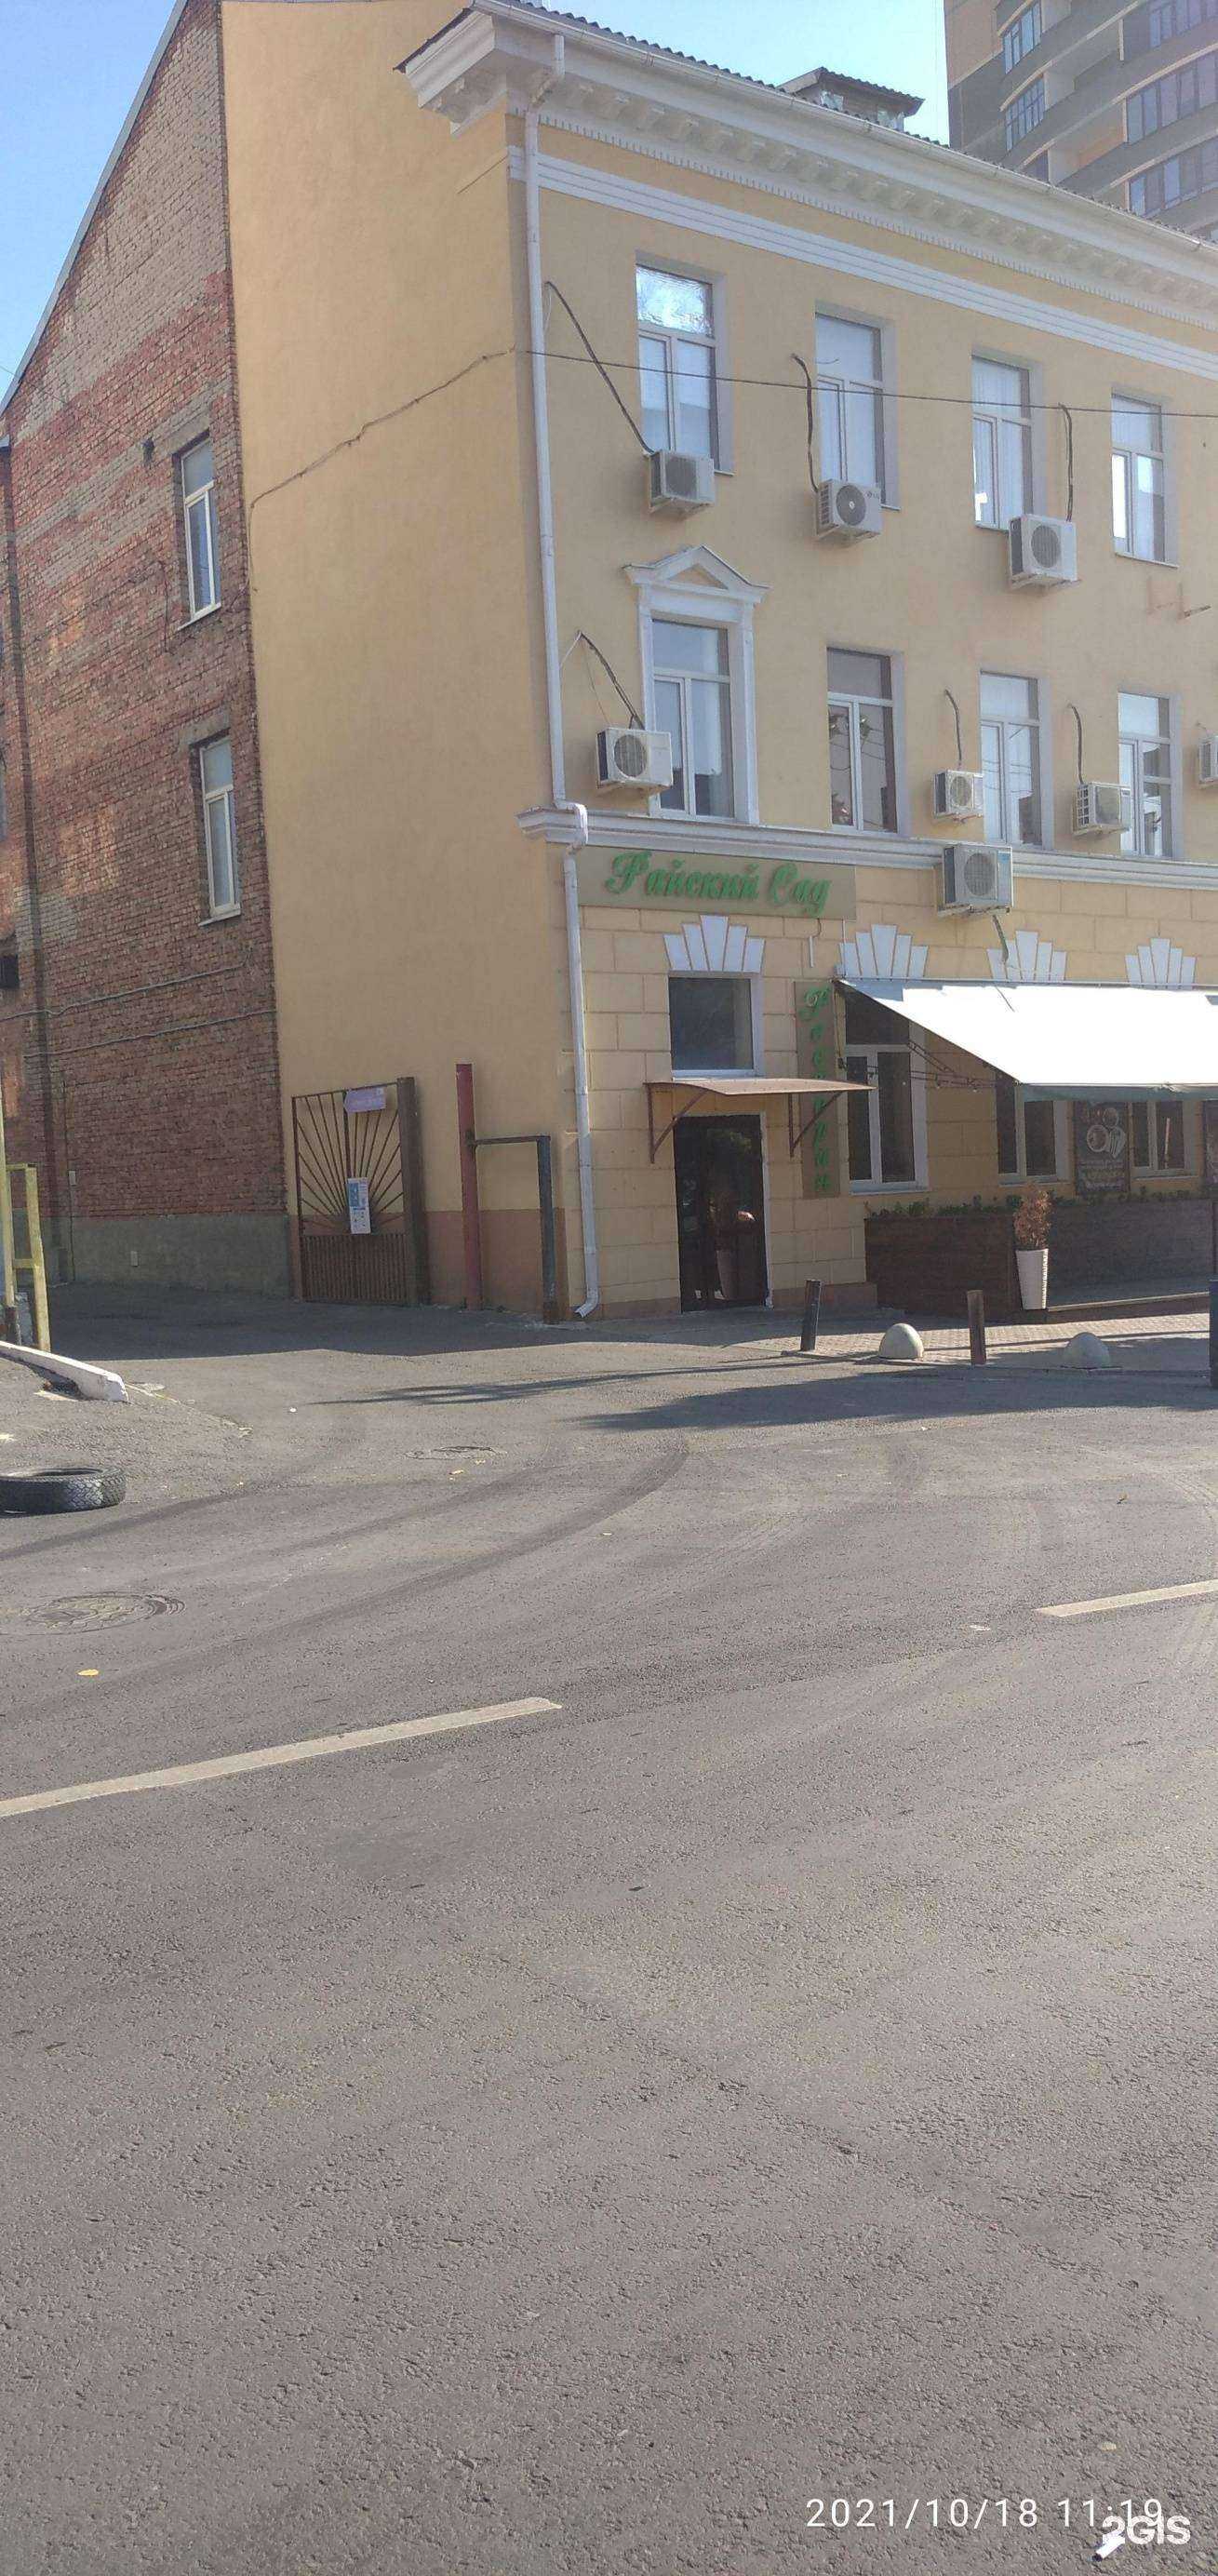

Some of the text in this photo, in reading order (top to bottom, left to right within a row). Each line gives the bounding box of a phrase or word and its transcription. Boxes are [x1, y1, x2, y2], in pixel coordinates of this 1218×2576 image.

[605, 850, 832, 917] Райский Сад
[798, 986, 832, 1192] Ресоран
